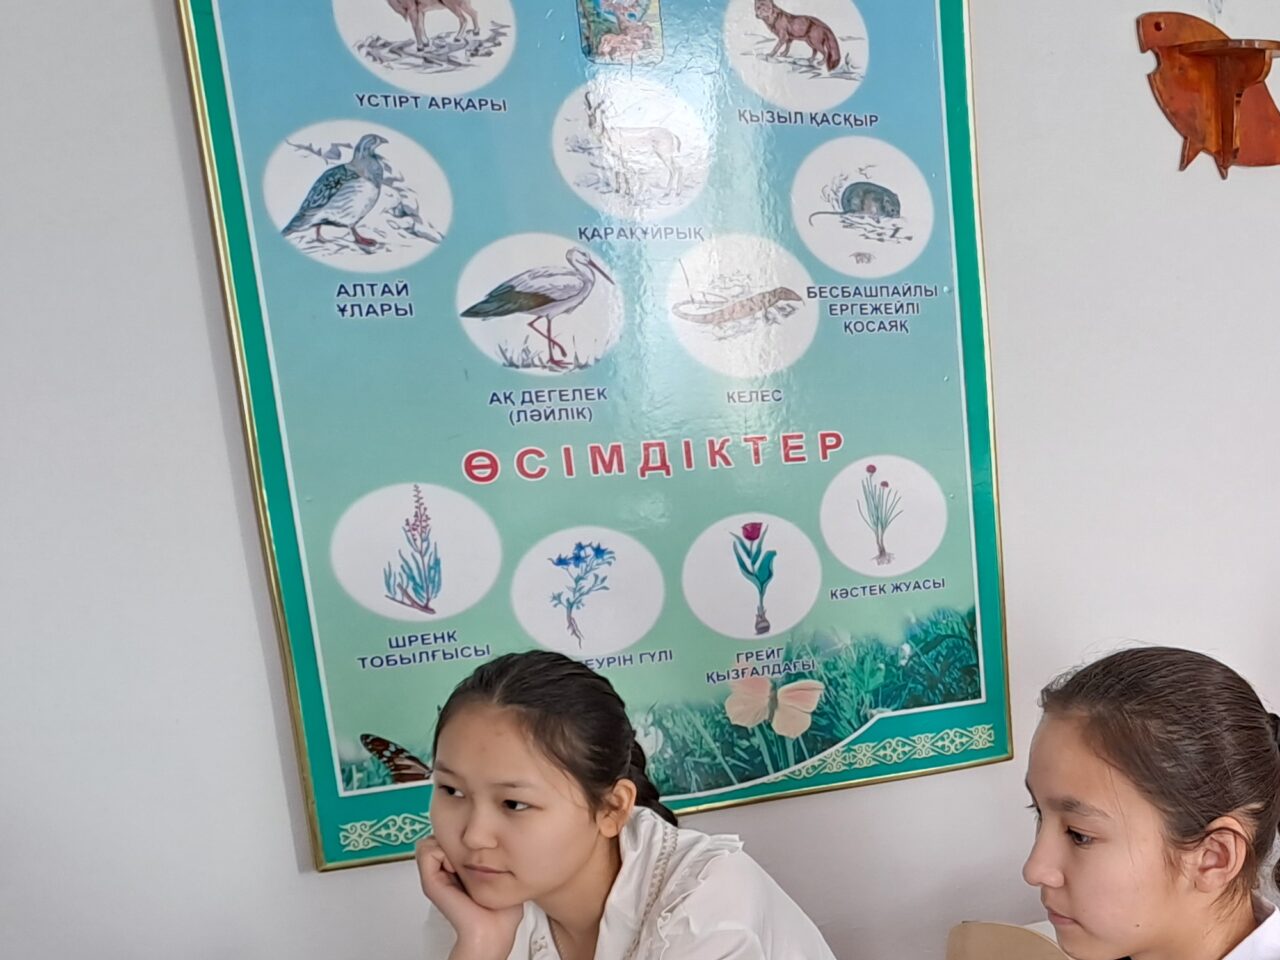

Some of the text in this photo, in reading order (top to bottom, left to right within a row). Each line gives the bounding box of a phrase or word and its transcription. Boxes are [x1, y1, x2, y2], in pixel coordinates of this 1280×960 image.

[356, 93, 508, 112] ҮСТІРТ АРҚАРЫ
[738, 108, 879, 129] ҚЫЗЫЛ ҚАСҚЫР
[579, 225, 704, 242] ҚАРАҚҰЙРЫҚ
[336, 280, 409, 298] АЛТАЙ
[806, 282, 939, 299] БЕСБАШПАЙЛЫ
[337, 302, 413, 318] ҰЛАРЫ
[829, 299, 920, 316] ЕРГЕЖЕЙЛІ
[844, 320, 909, 334] ҚОСАЯҚ
[489, 387, 608, 408] АҚ ДЕГЕЛЕК
[727, 389, 782, 404] КЕЛЕС
[508, 406, 593, 425] (ЛӘЙЛІК)
[463, 431, 844, 484] ӨСІМДІКТЕР
[830, 578, 945, 600] КӘСТЕК ЖУАСЫ
[388, 630, 458, 649] ШРЕНК
[357, 644, 490, 669] ТОБЫЛҒЫСЫ
[584, 650, 673, 669] ЕУРІН ГҮЛІ
[736, 647, 784, 663] ГРЕЙГ
[706, 660, 816, 684] ҚЫЗҒАЛДАҒЫ
